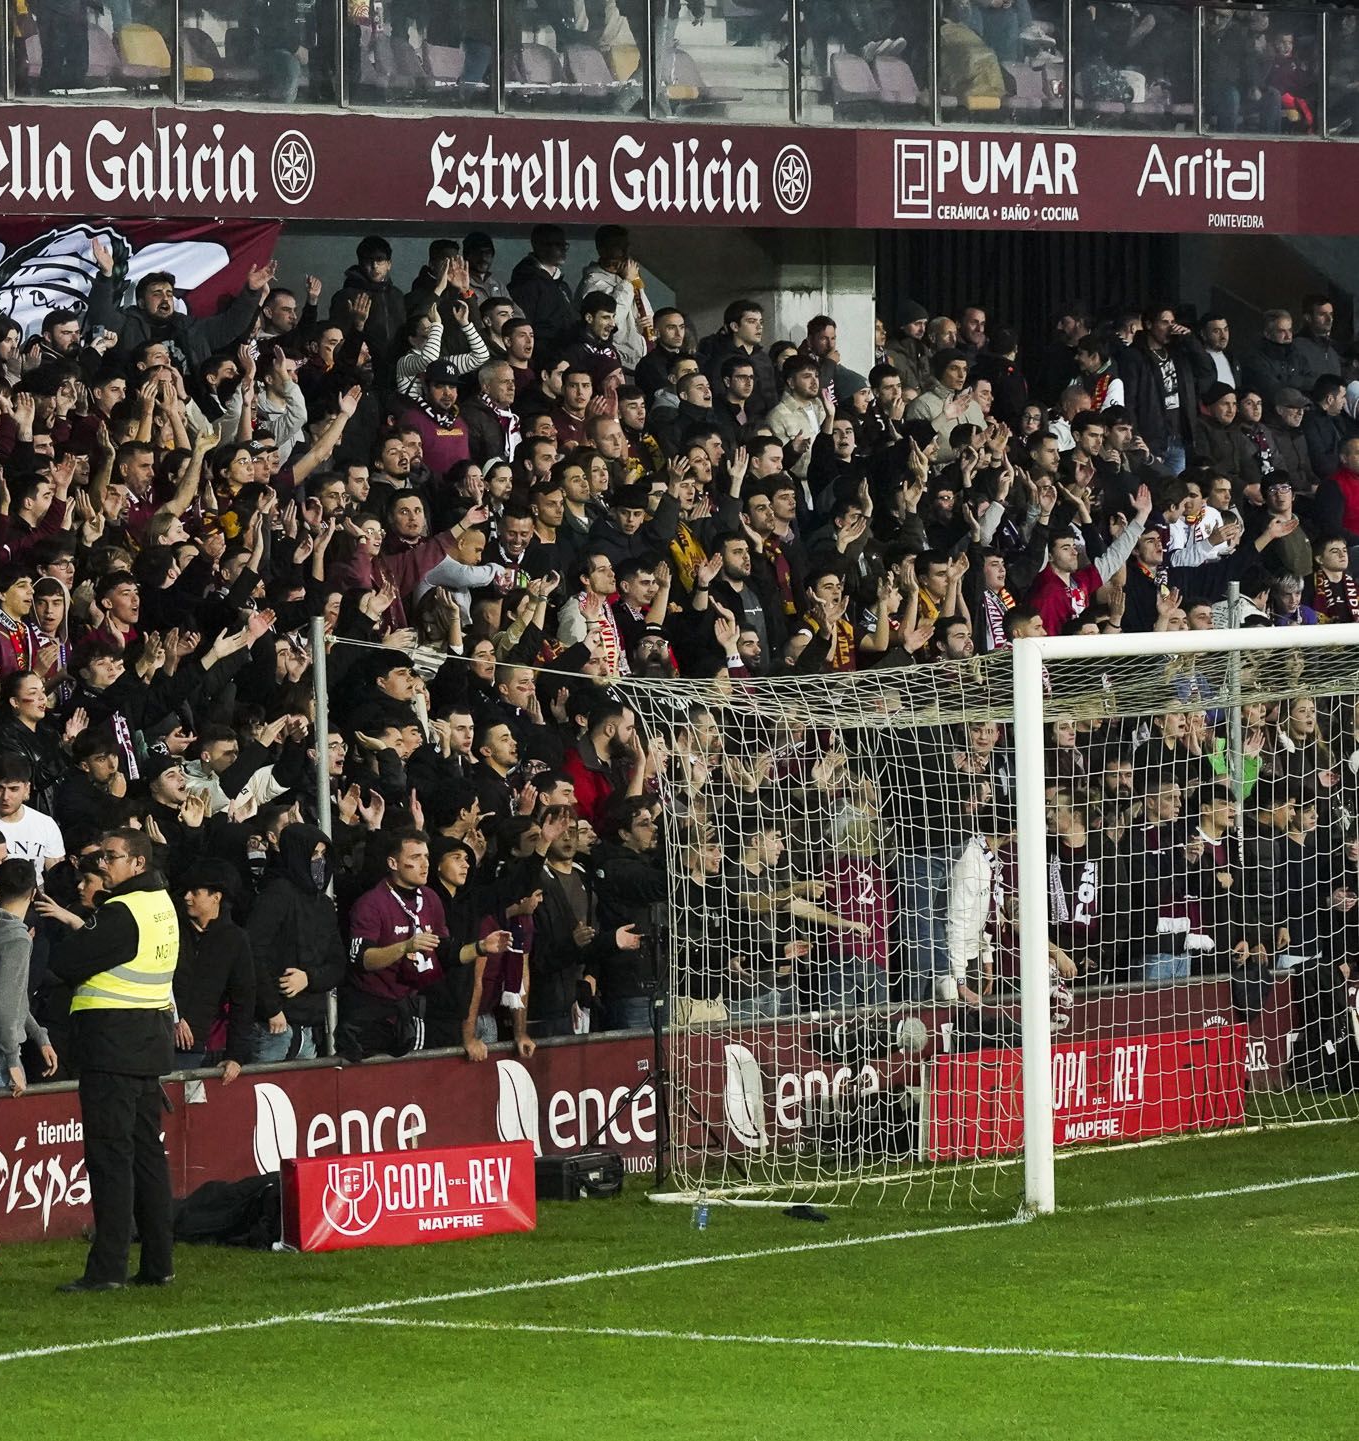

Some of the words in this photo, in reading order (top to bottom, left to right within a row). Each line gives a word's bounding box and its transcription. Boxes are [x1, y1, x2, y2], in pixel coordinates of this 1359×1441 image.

[86, 119, 258, 204] Galicia
[426, 131, 600, 211] Estrella
[610, 135, 761, 213] Galicia
[938, 140, 1078, 194] PUMAR
[1137, 144, 1264, 201] Arrital
[937, 203, 989, 220] CERÁMICA
[1001, 203, 1030, 221] BAÑO
[1041, 207, 1079, 221] COCINA
[1208, 213, 1264, 228] PONTEVEDRA
[857, 872, 876, 905] 2
[1052, 1050, 1086, 1110] OPA
[1093, 1096, 1107, 1105] DEL
[1113, 1043, 1148, 1103] REY
[37, 1118, 84, 1145] tienda
[549, 1085, 656, 1149] ence
[1065, 1118, 1119, 1140] MAPFRE
[384, 1161, 448, 1212] COPA
[469, 1157, 512, 1204] REY
[418, 1214, 483, 1231] MAPFRE
